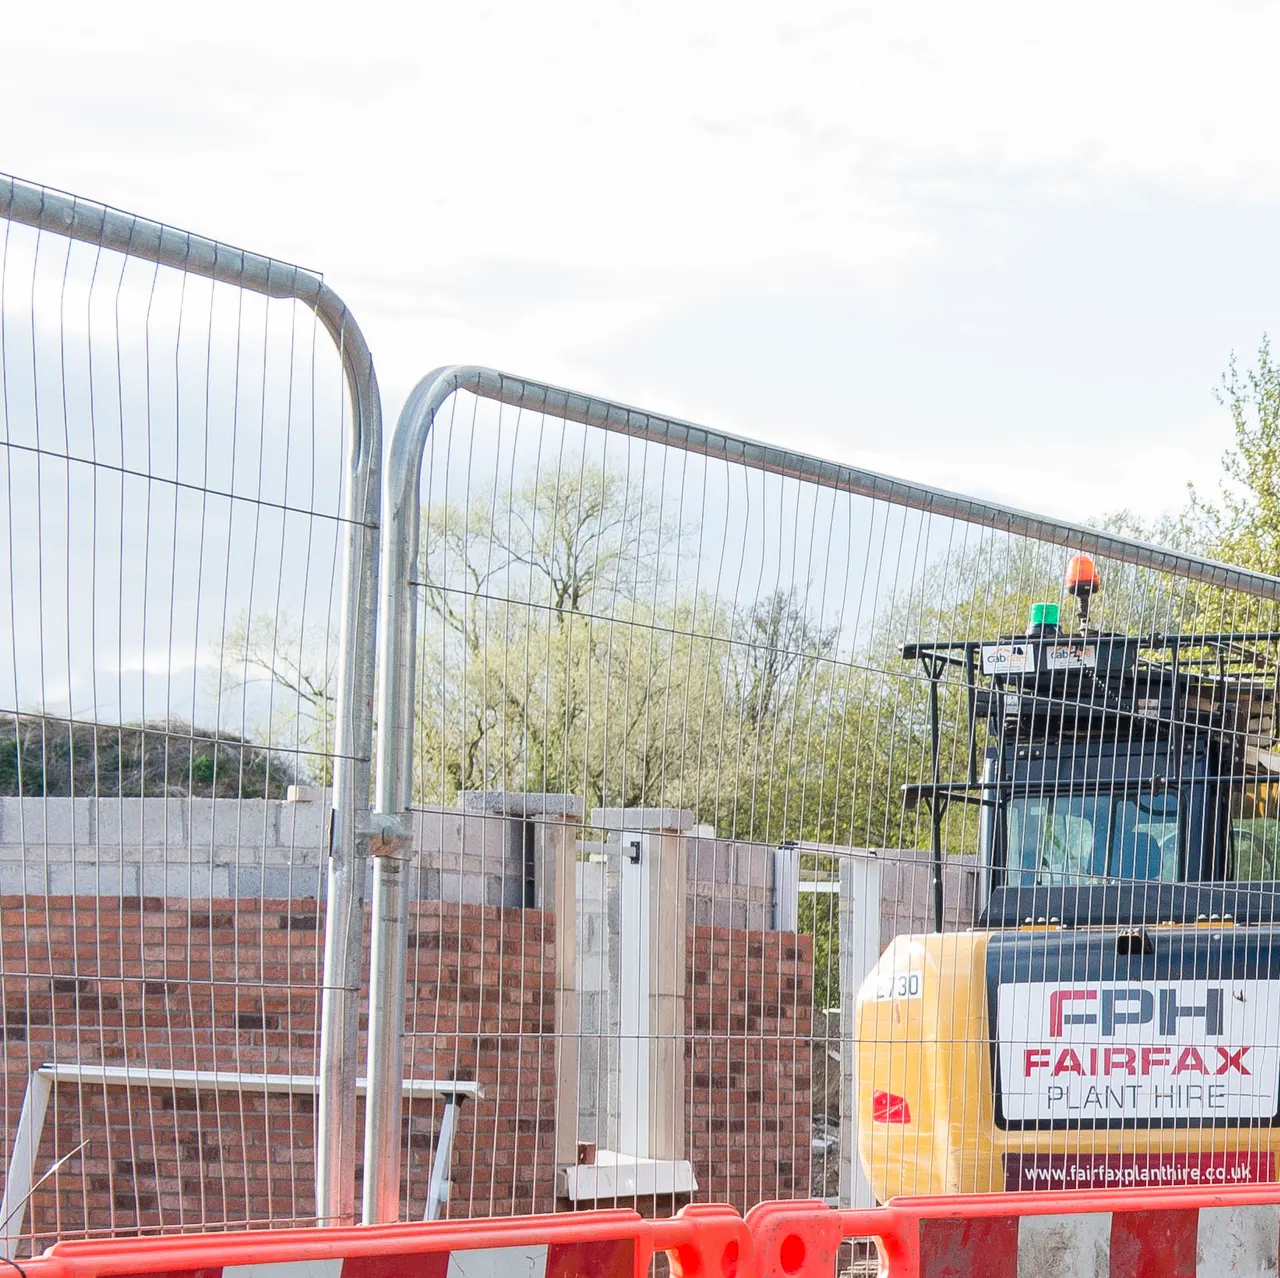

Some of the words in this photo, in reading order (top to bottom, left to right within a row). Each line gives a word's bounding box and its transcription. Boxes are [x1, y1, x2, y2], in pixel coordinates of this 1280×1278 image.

[1049, 988, 1224, 1038] FPH
[1024, 1045, 1253, 1078] FAIRFAX
[1047, 1085, 1143, 1110] PLANT
[1155, 1084, 1225, 1109] HIRE
[1024, 1162, 1252, 1187] www.fairfaxplanthire.co.uk
